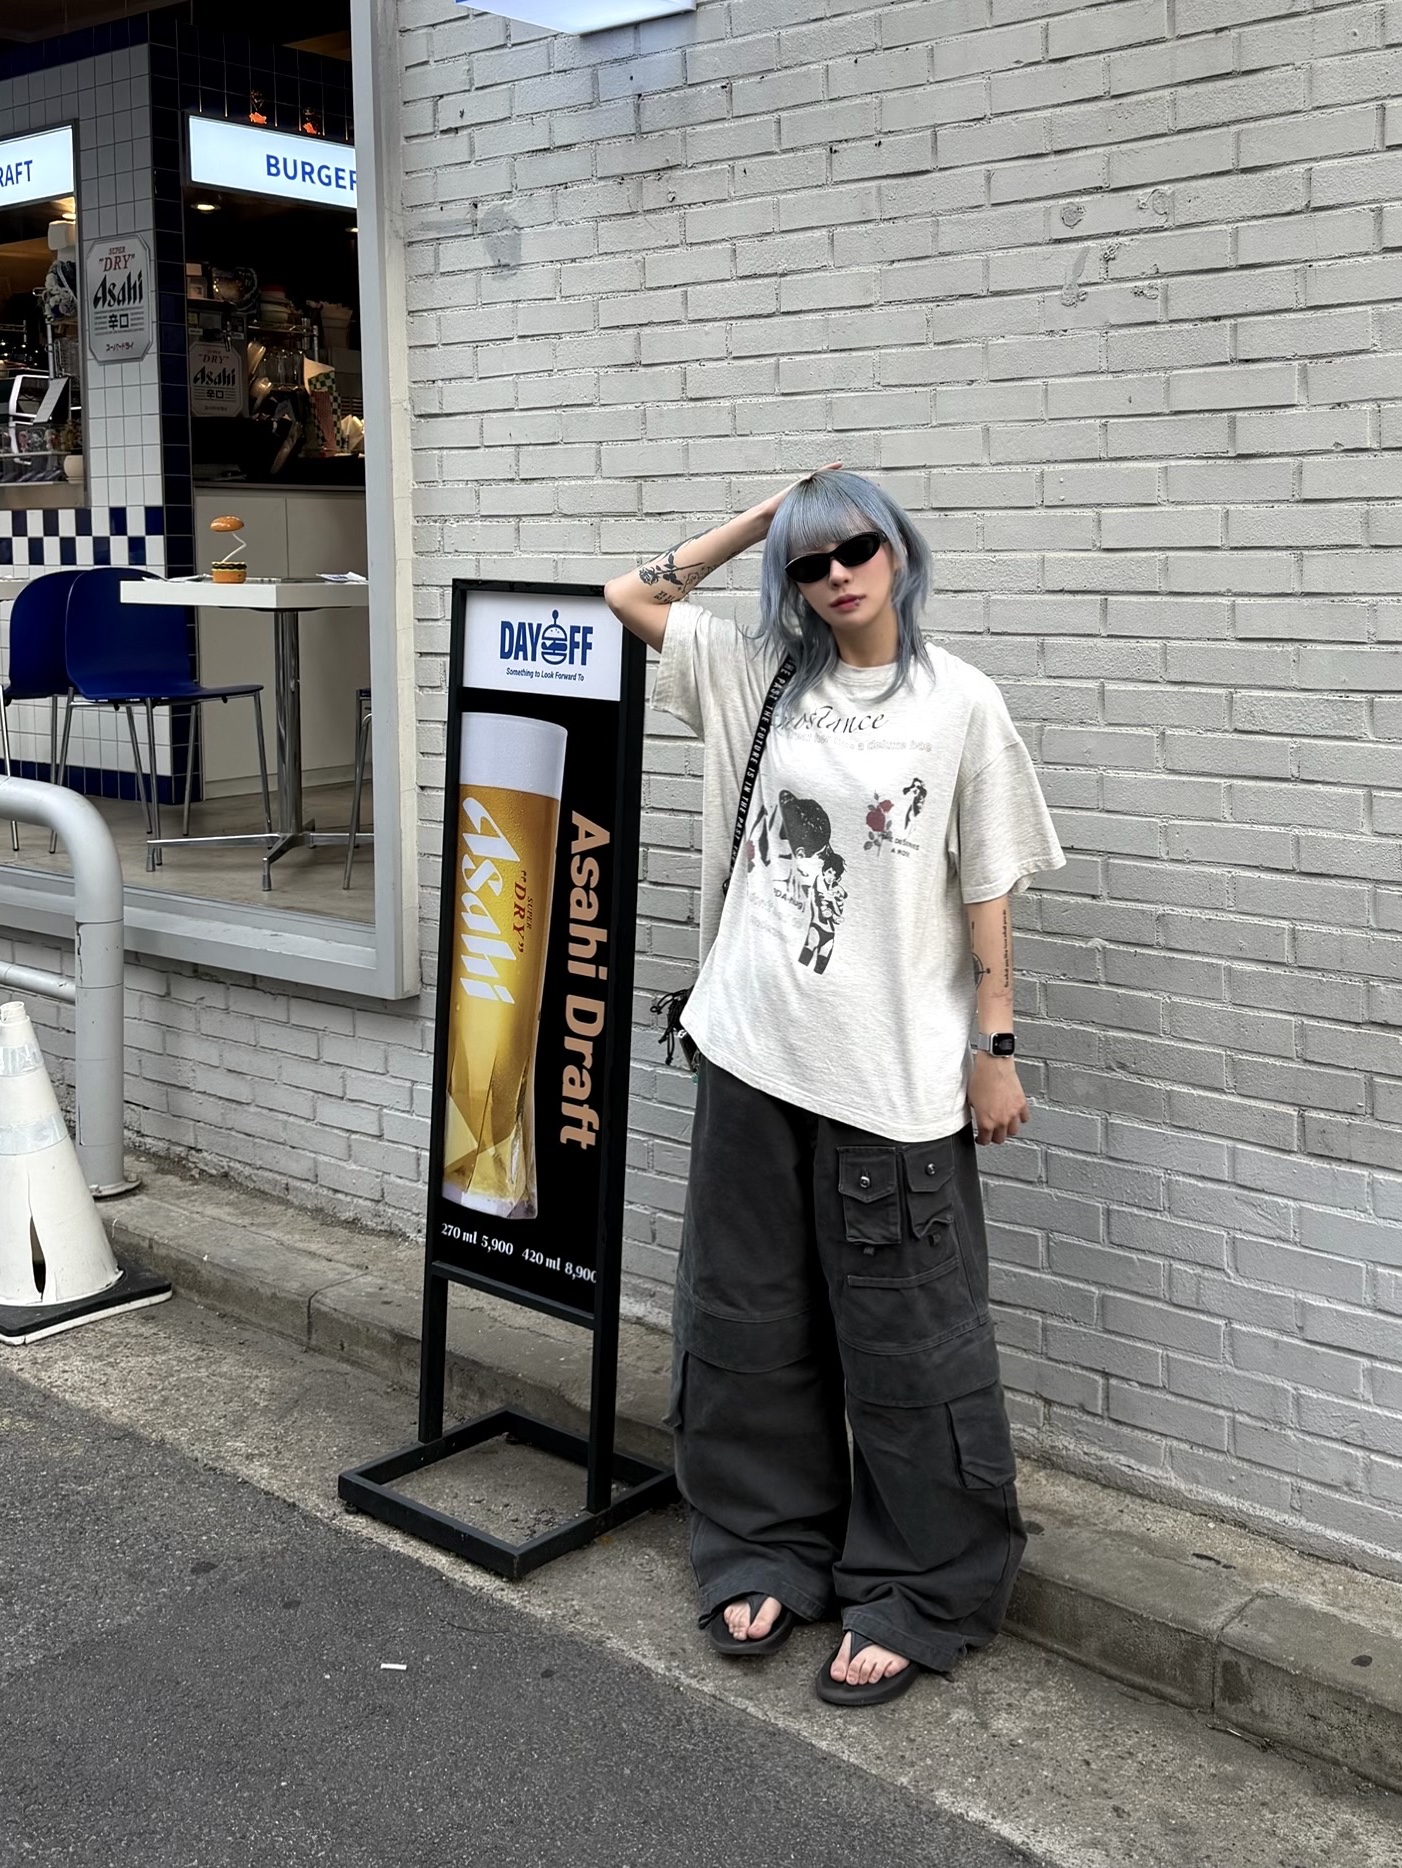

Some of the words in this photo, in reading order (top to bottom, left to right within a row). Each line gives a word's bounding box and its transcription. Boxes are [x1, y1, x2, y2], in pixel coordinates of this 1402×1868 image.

[93, 269, 143, 309] Asahi
[108, 313, 129, 330] 辛口
[192, 366, 236, 386] Asahi
[506, 667, 534, 679] Something
[534, 670, 541, 678] to
[541, 670, 555, 679] Look
[555, 671, 577, 681] Forward
[577, 673, 585, 682] To
[780, 659, 796, 676] HE
[761, 705, 774, 723] THE
[750, 726, 767, 764] FUTURE
[746, 767, 756, 778] IS
[743, 781, 752, 793] IN
[460, 797, 521, 1005] Asahi
[568, 810, 610, 980] Asahi
[526, 896, 534, 930] SUPER
[560, 994, 606, 1150] Draft
[441, 1223, 461, 1239] 270
[462, 1231, 477, 1245] ml
[481, 1235, 514, 1256] 5,900
[521, 1248, 544, 1265] 420
[545, 1257, 560, 1271] ml
